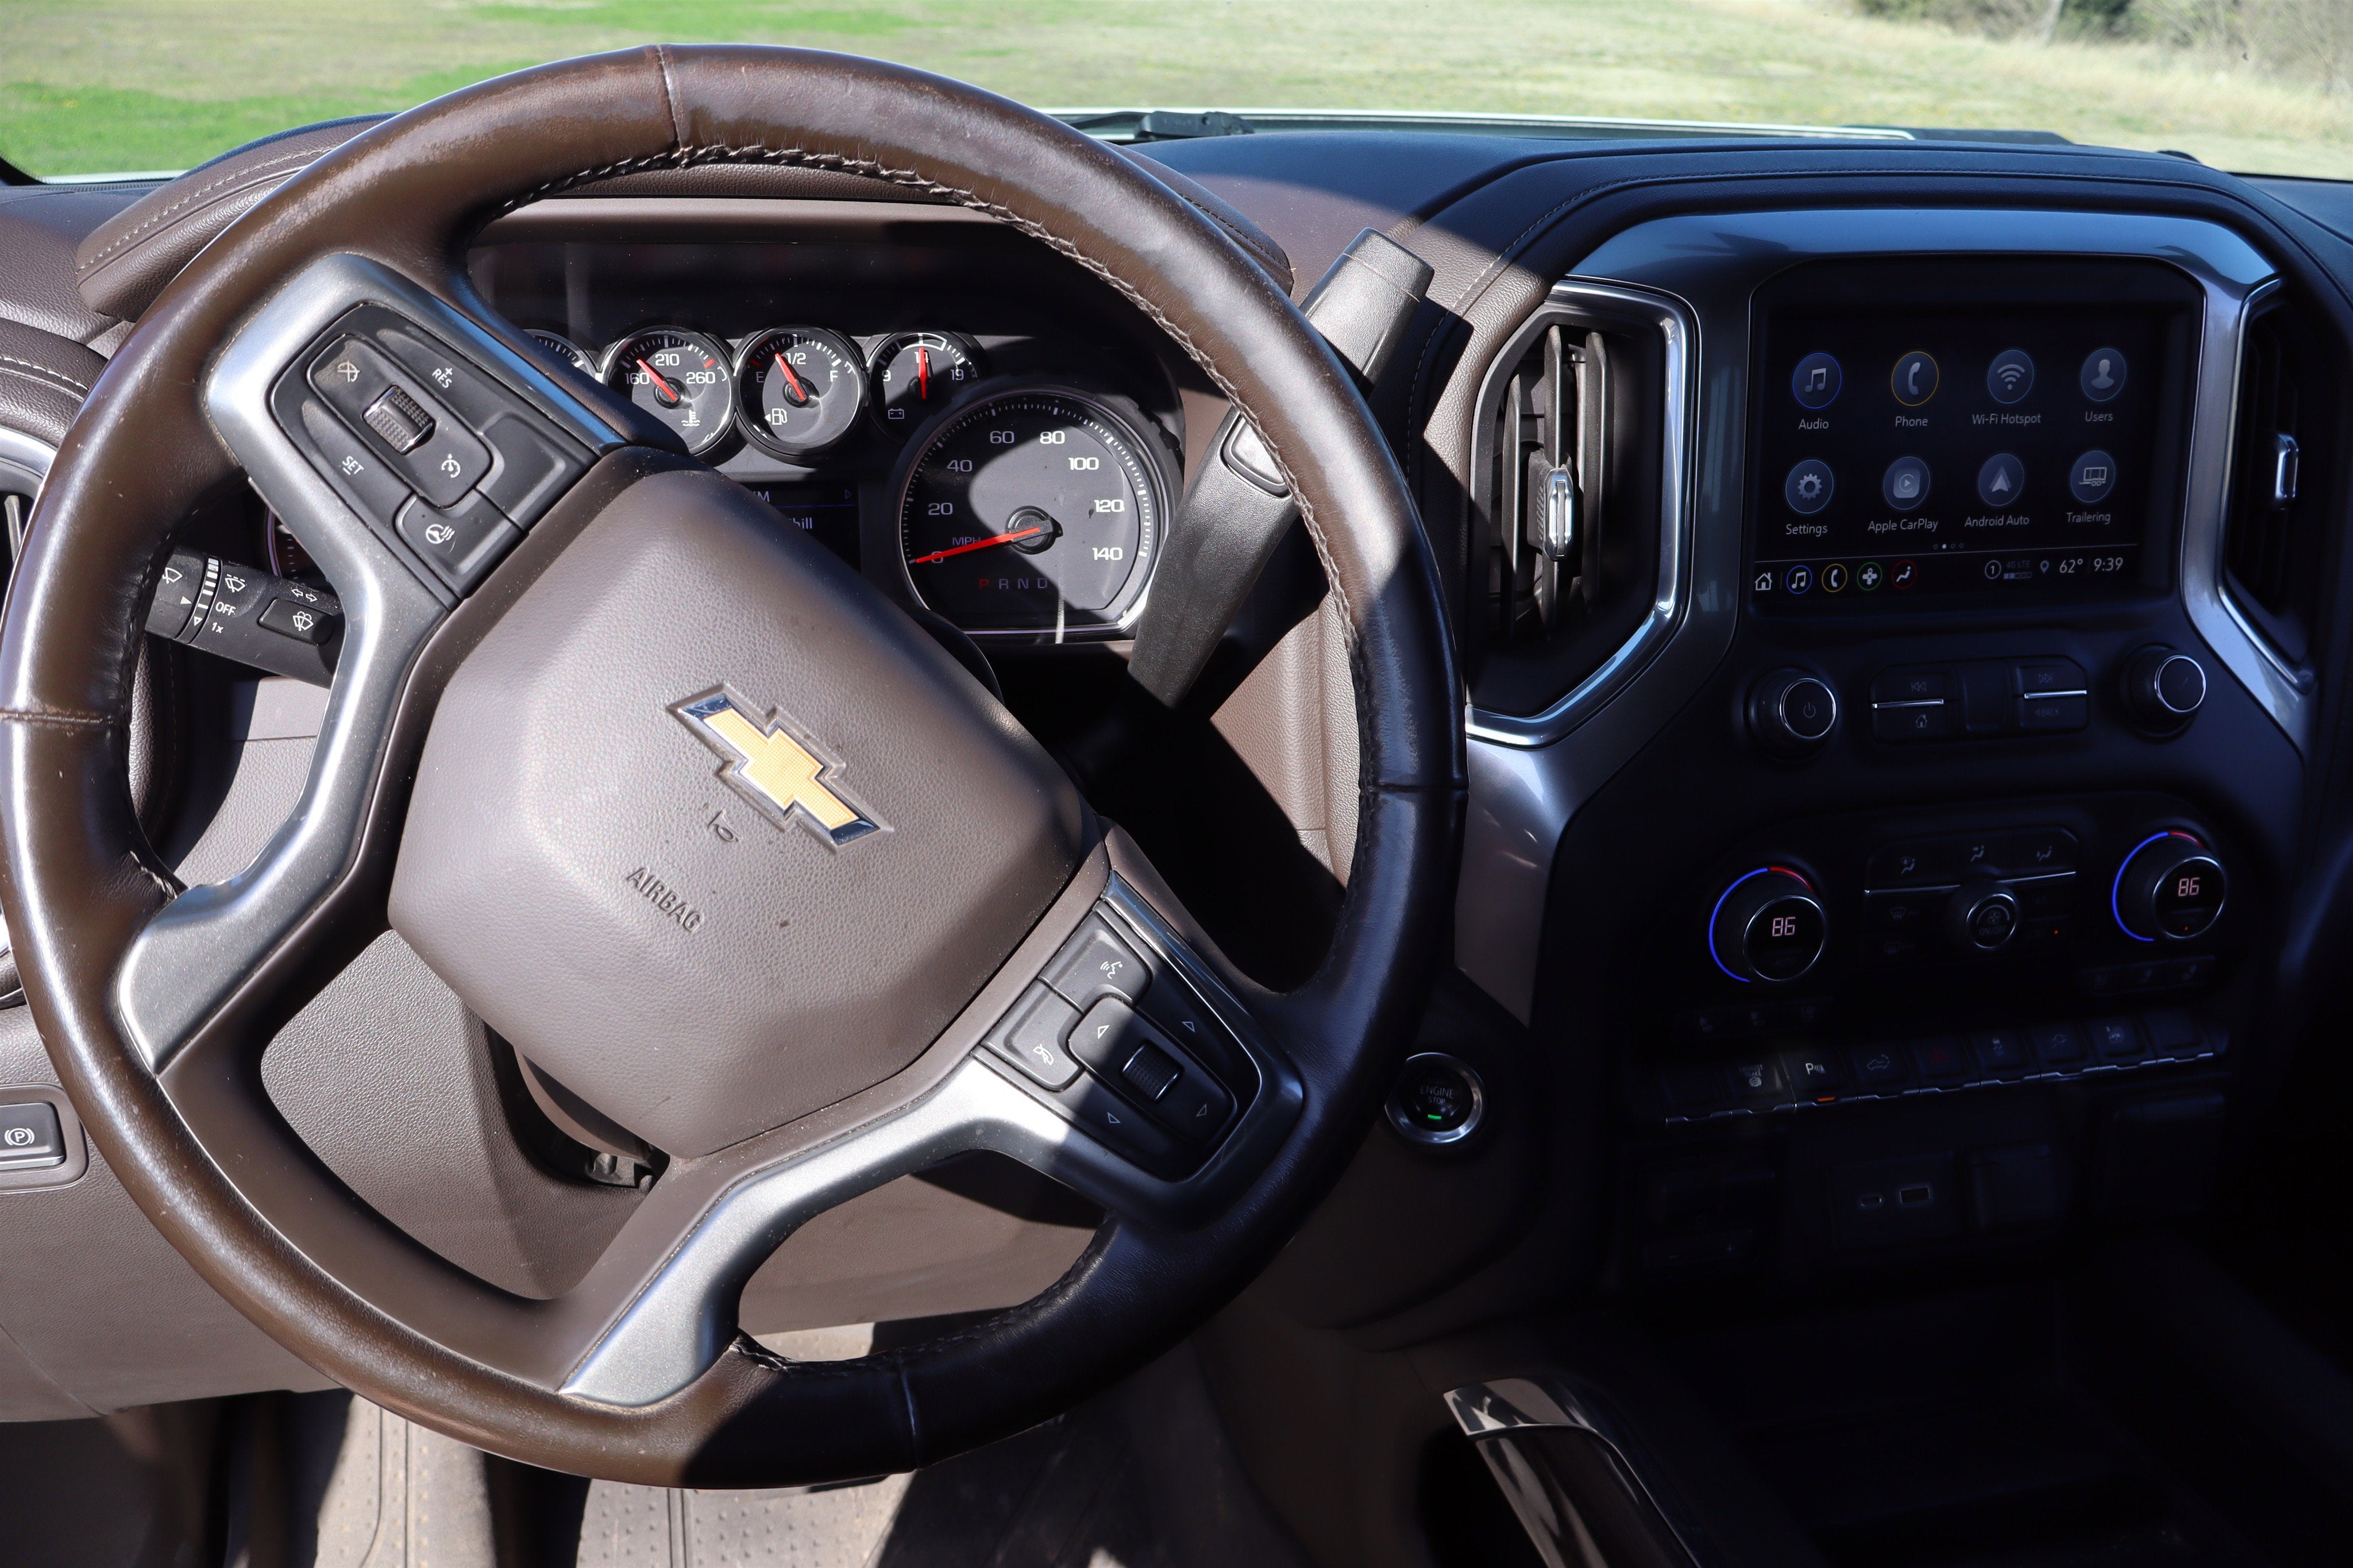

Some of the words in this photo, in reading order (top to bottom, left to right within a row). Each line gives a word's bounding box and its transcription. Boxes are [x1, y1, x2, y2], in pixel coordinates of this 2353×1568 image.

[655, 353, 680, 366] 210
[786, 352, 807, 365] 1/2
[433, 368, 453, 389] RES
[626, 373, 650, 385] 160
[686, 372, 716, 384] 260
[756, 371, 765, 383] E
[830, 370, 839, 383] F
[882, 370, 892, 382] 9
[950, 369, 964, 381] 19
[1895, 416, 1928, 428] Phone
[1972, 414, 1999, 424] Wi-Fi
[2000, 412, 2042, 426] Hotspot
[2085, 410, 2113, 422] Users
[1798, 419, 1829, 430] Audio
[990, 431, 1015, 444] 60
[1039, 431, 1065, 445] 80
[342, 456, 364, 474] SET
[947, 459, 973, 473] 40
[1068, 457, 1100, 470] 100
[928, 503, 953, 516] 20
[1094, 499, 1124, 513] 120
[1965, 515, 2004, 527] Android
[2007, 515, 2030, 526] Auto
[2066, 512, 2111, 525] Trailering
[1785, 523, 1828, 536] Settings
[1868, 521, 1897, 534] Apple
[1899, 519, 1939, 532] CarPlay
[952, 536, 981, 546] MPH
[1093, 547, 1123, 561] 140
[2059, 558, 2083, 573] 62°
[2093, 557, 2123, 571] 9:39
[979, 579, 989, 589] P
[998, 578, 1009, 589] R
[1017, 578, 1029, 589] N
[1037, 578, 1048, 589] D
[215, 601, 236, 616] OFF
[211, 622, 224, 634] 1x
[2178, 877, 2201, 897] 86
[626, 866, 705, 933] AIRBAG
[1772, 916, 1796, 937] 86
[1420, 1085, 1454, 1099] ENGINE
[1428, 1096, 1445, 1105] STOP
